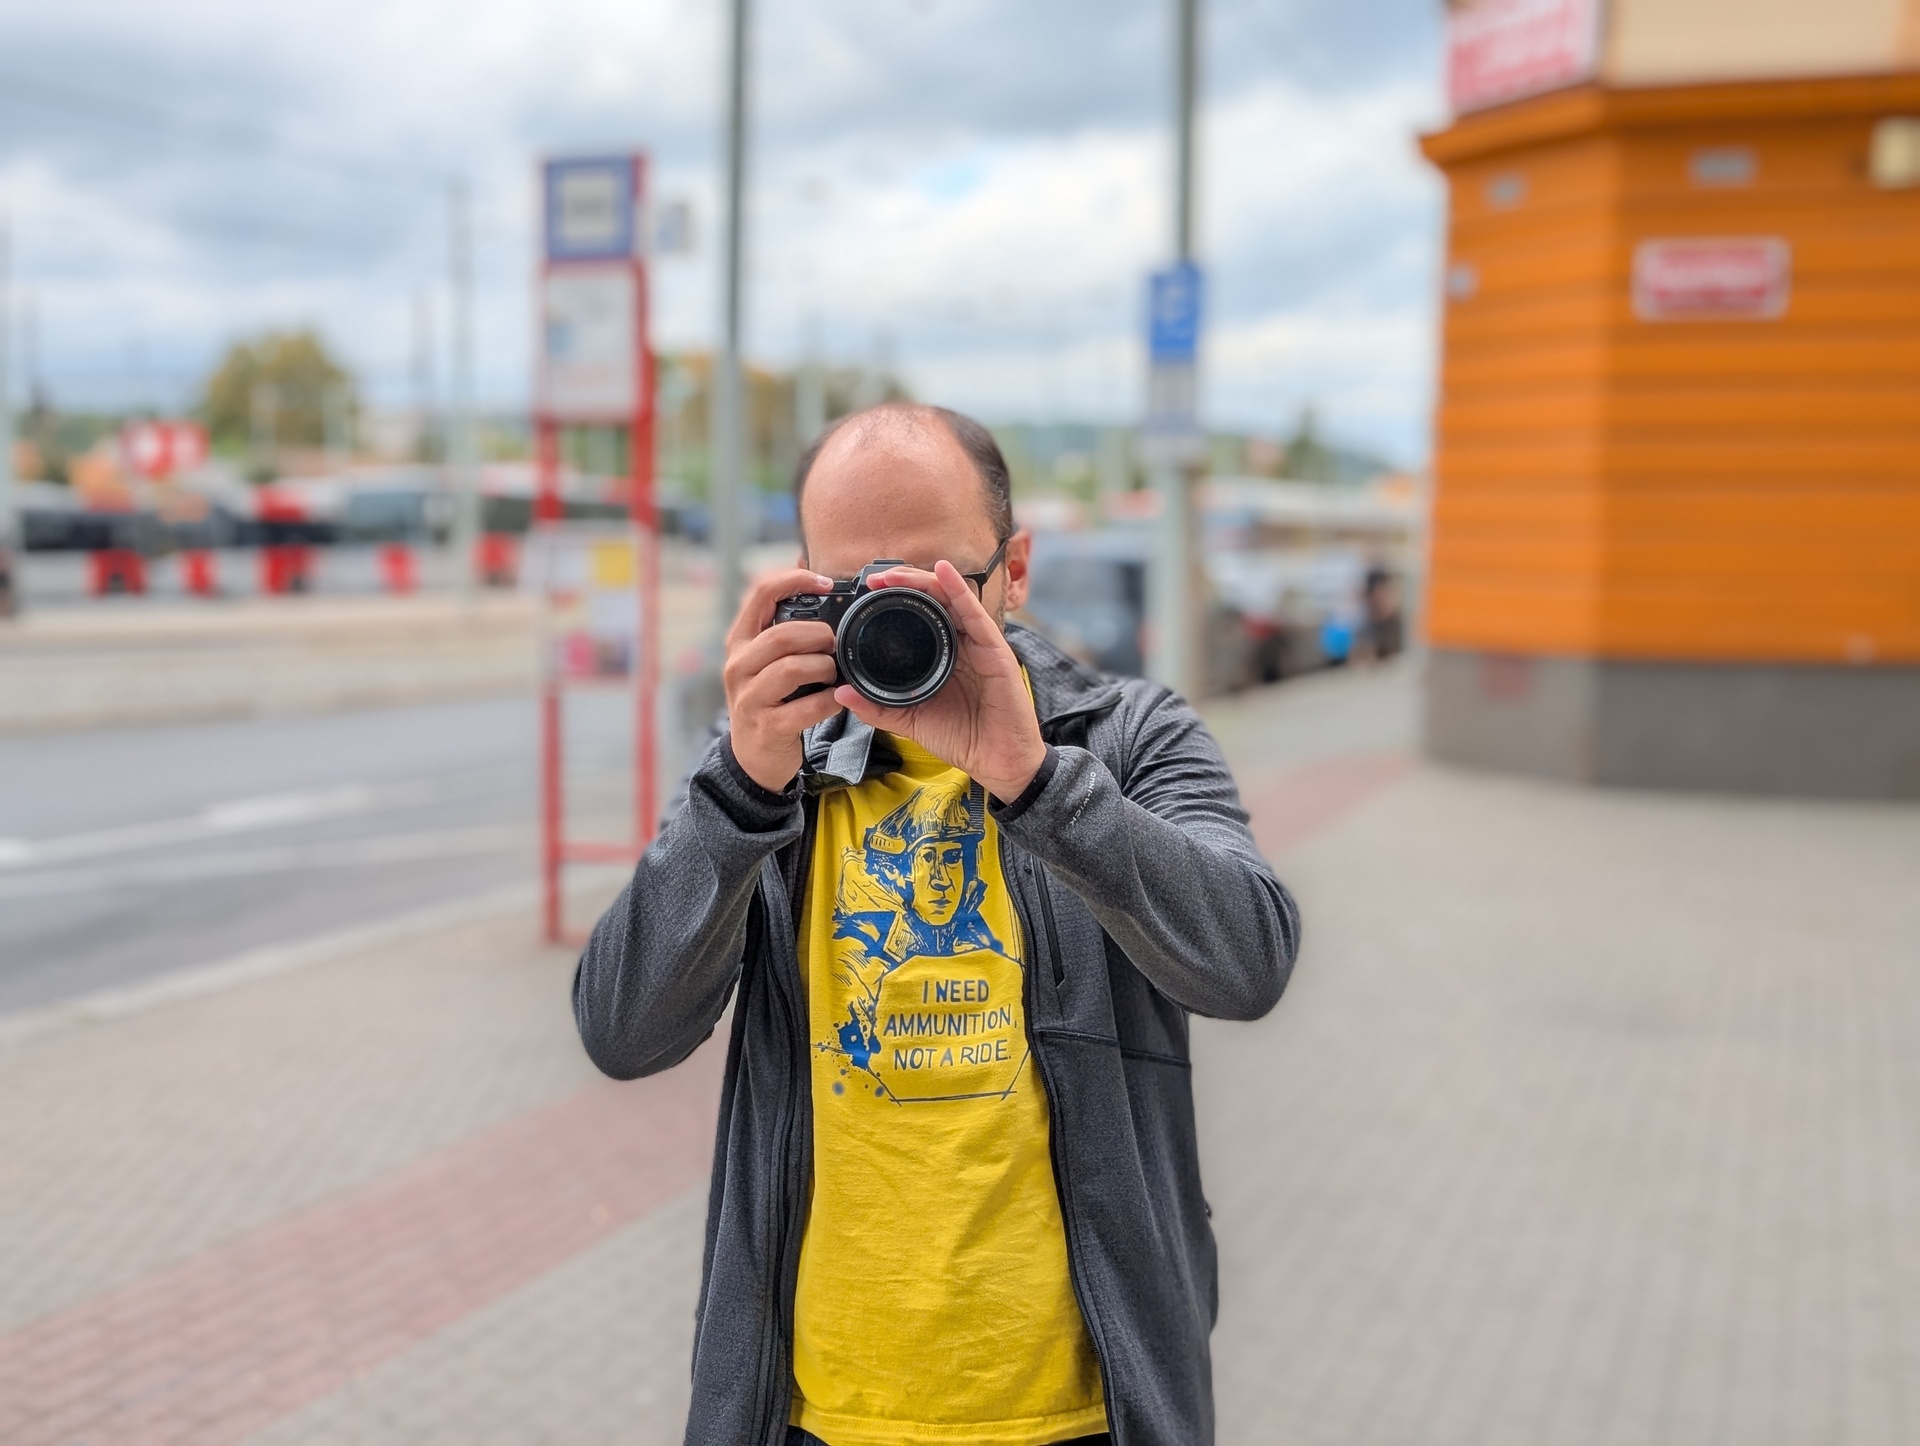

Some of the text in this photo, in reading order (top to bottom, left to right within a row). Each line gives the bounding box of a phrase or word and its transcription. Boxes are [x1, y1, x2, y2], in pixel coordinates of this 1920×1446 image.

[1069, 771, 1096, 826] OMNI-WICK
[923, 979, 989, 1004] I NEED
[894, 1048, 937, 1070] NOT
[939, 1047, 953, 1067] A
